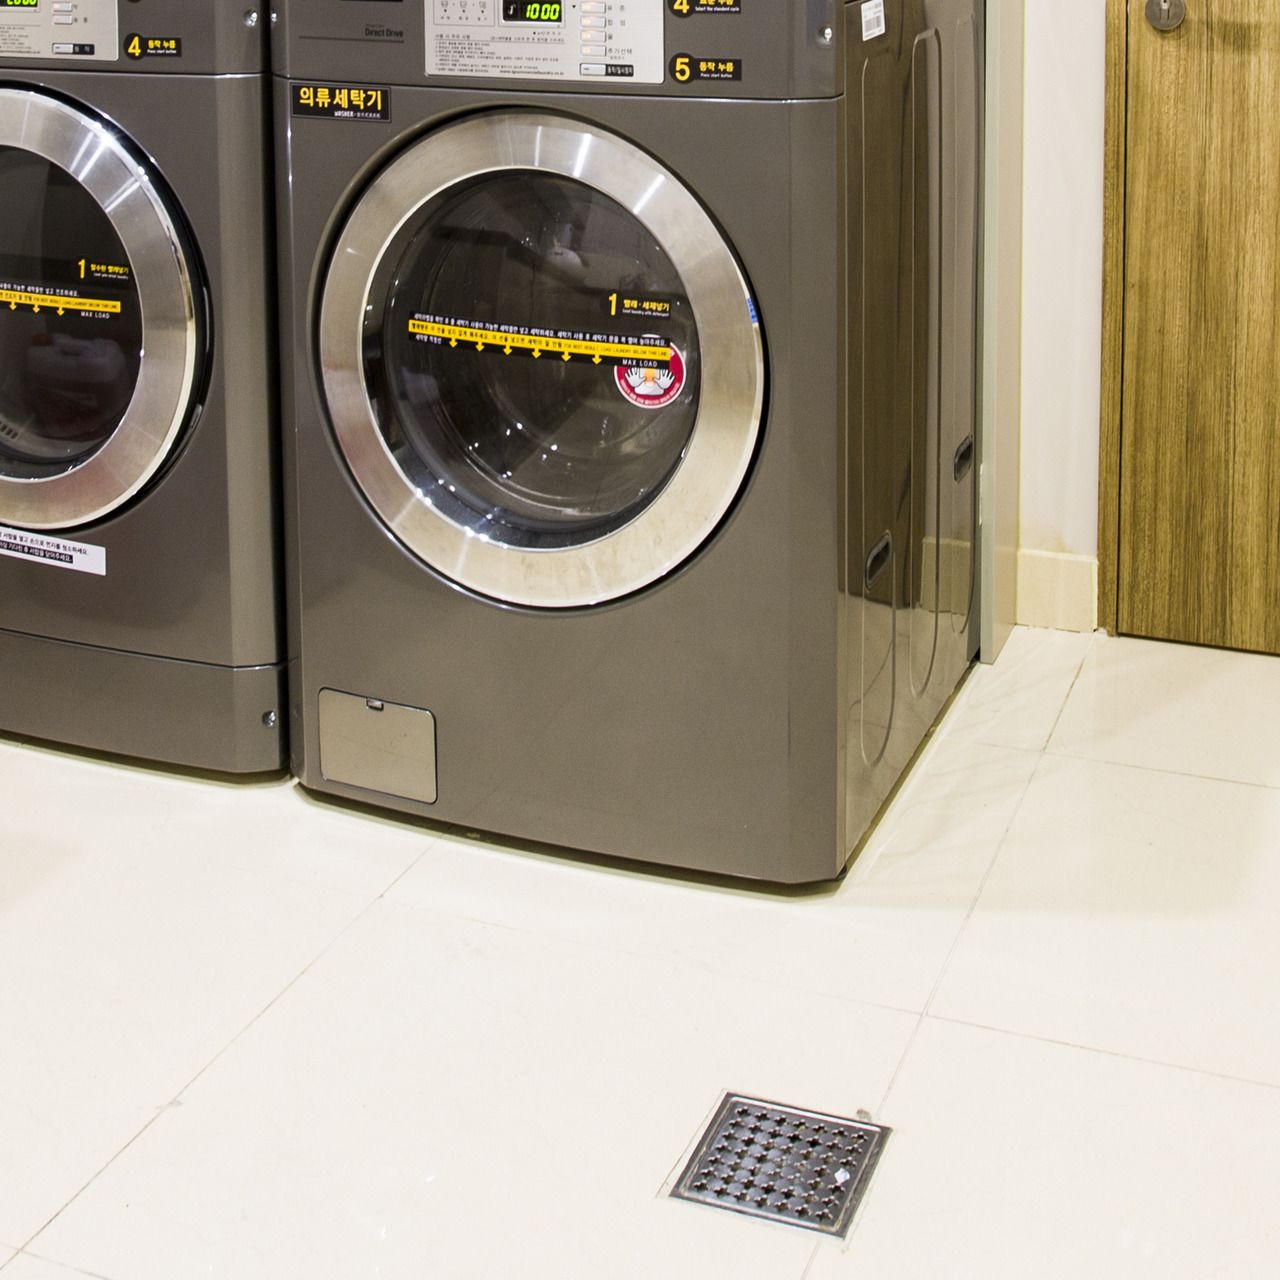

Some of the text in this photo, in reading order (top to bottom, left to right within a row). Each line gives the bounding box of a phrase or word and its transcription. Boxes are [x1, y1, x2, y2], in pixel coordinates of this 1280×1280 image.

[526, 3, 560, 19] 1000
[365, 28, 403, 38] Direct Drive
[127, 36, 141, 56] 4
[675, 58, 690, 81] 5
[78, 259, 84, 278] 1
[608, 293, 616, 315] 1
[639, 359, 657, 367] LOAD
